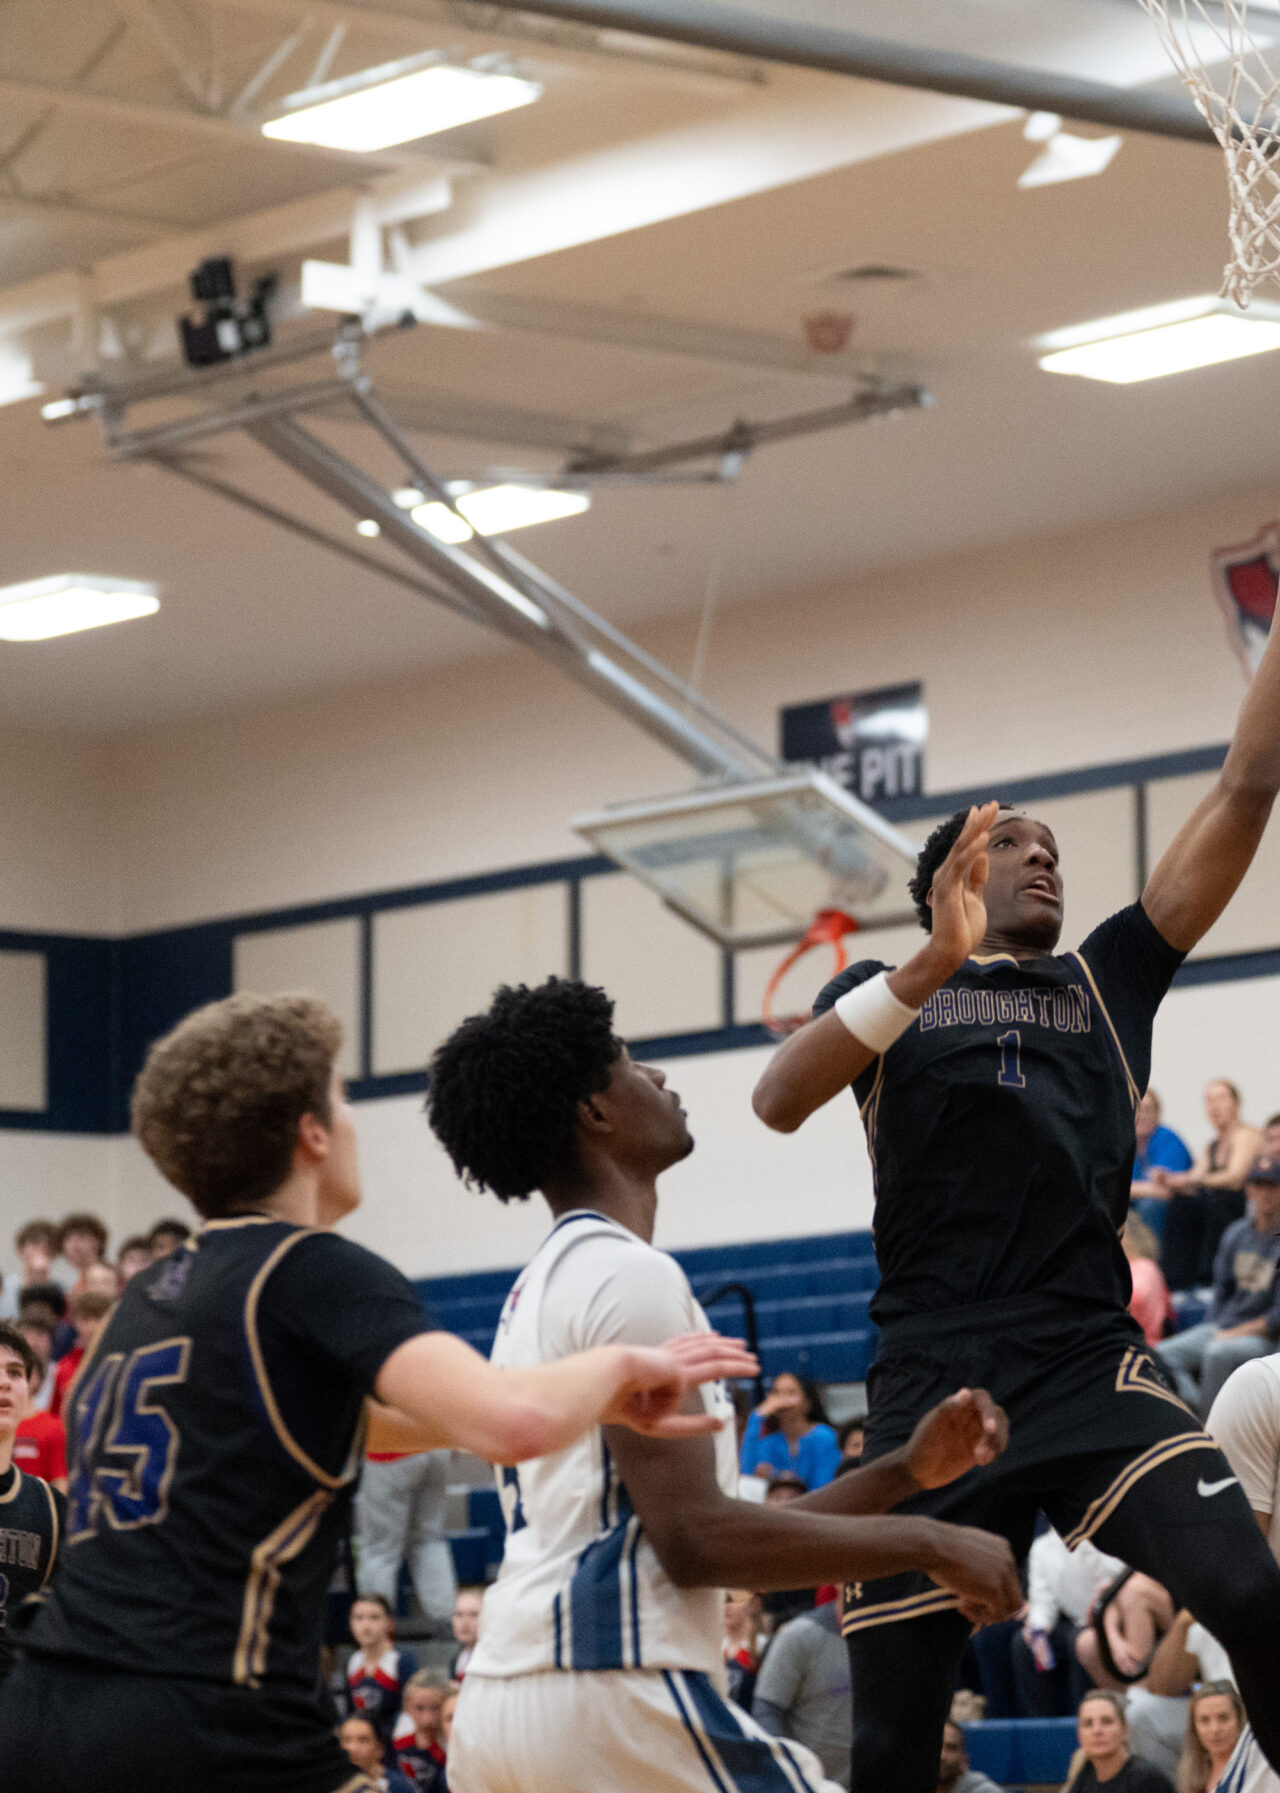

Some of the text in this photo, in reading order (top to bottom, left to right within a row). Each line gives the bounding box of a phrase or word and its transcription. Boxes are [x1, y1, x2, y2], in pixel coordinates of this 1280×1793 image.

[860, 742, 921, 800] PIT
[920, 984, 1091, 1033] BROUGHTON
[997, 1030, 1026, 1088] 1
[66, 1334, 193, 1545] 15
